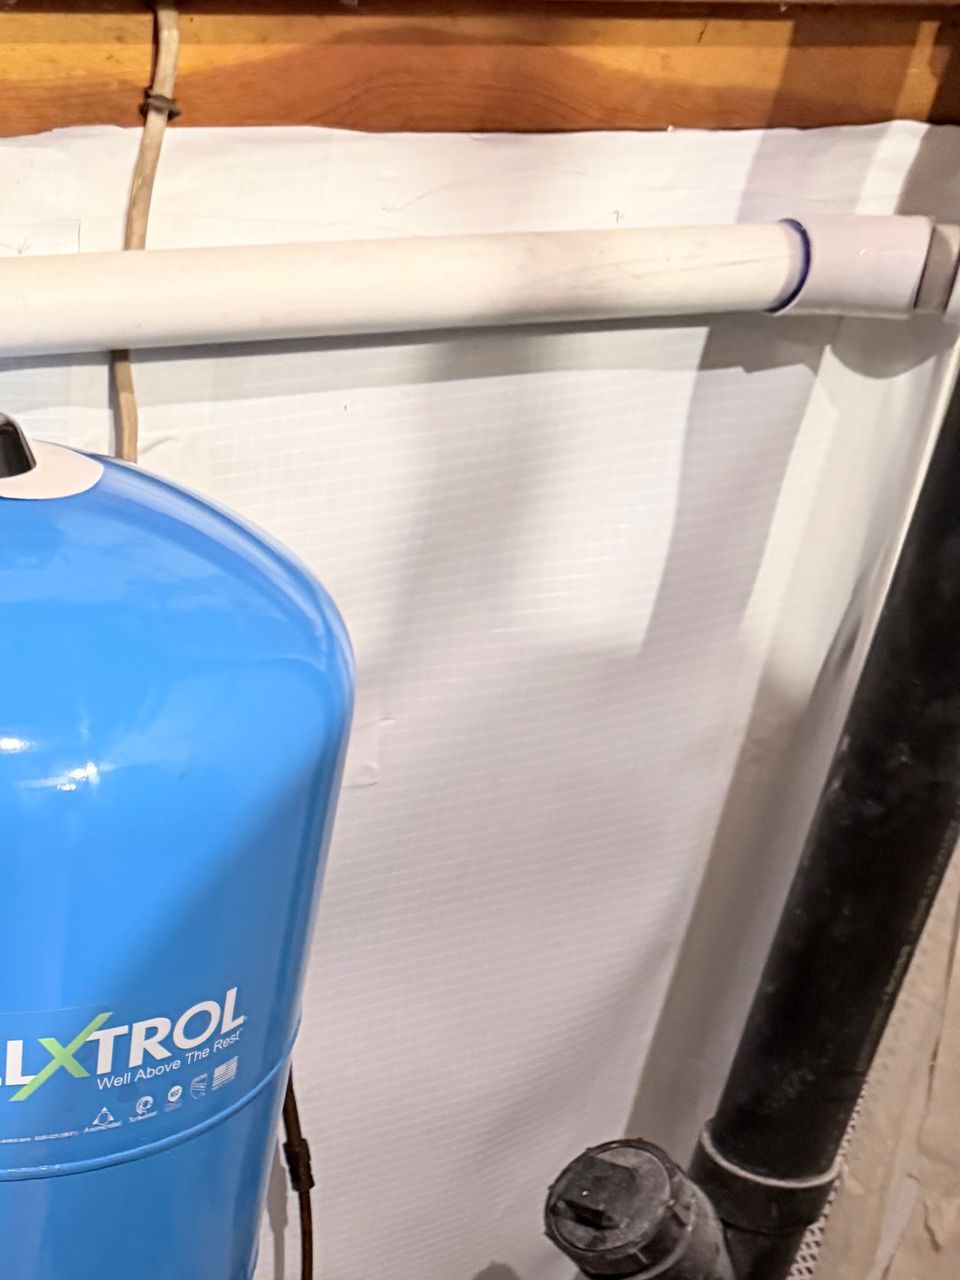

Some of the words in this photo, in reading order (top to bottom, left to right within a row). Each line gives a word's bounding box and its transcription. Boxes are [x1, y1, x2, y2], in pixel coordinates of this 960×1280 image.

[96, 1072, 131, 1090] Well
[134, 1060, 181, 1082] Above
[185, 1049, 209, 1065] The
